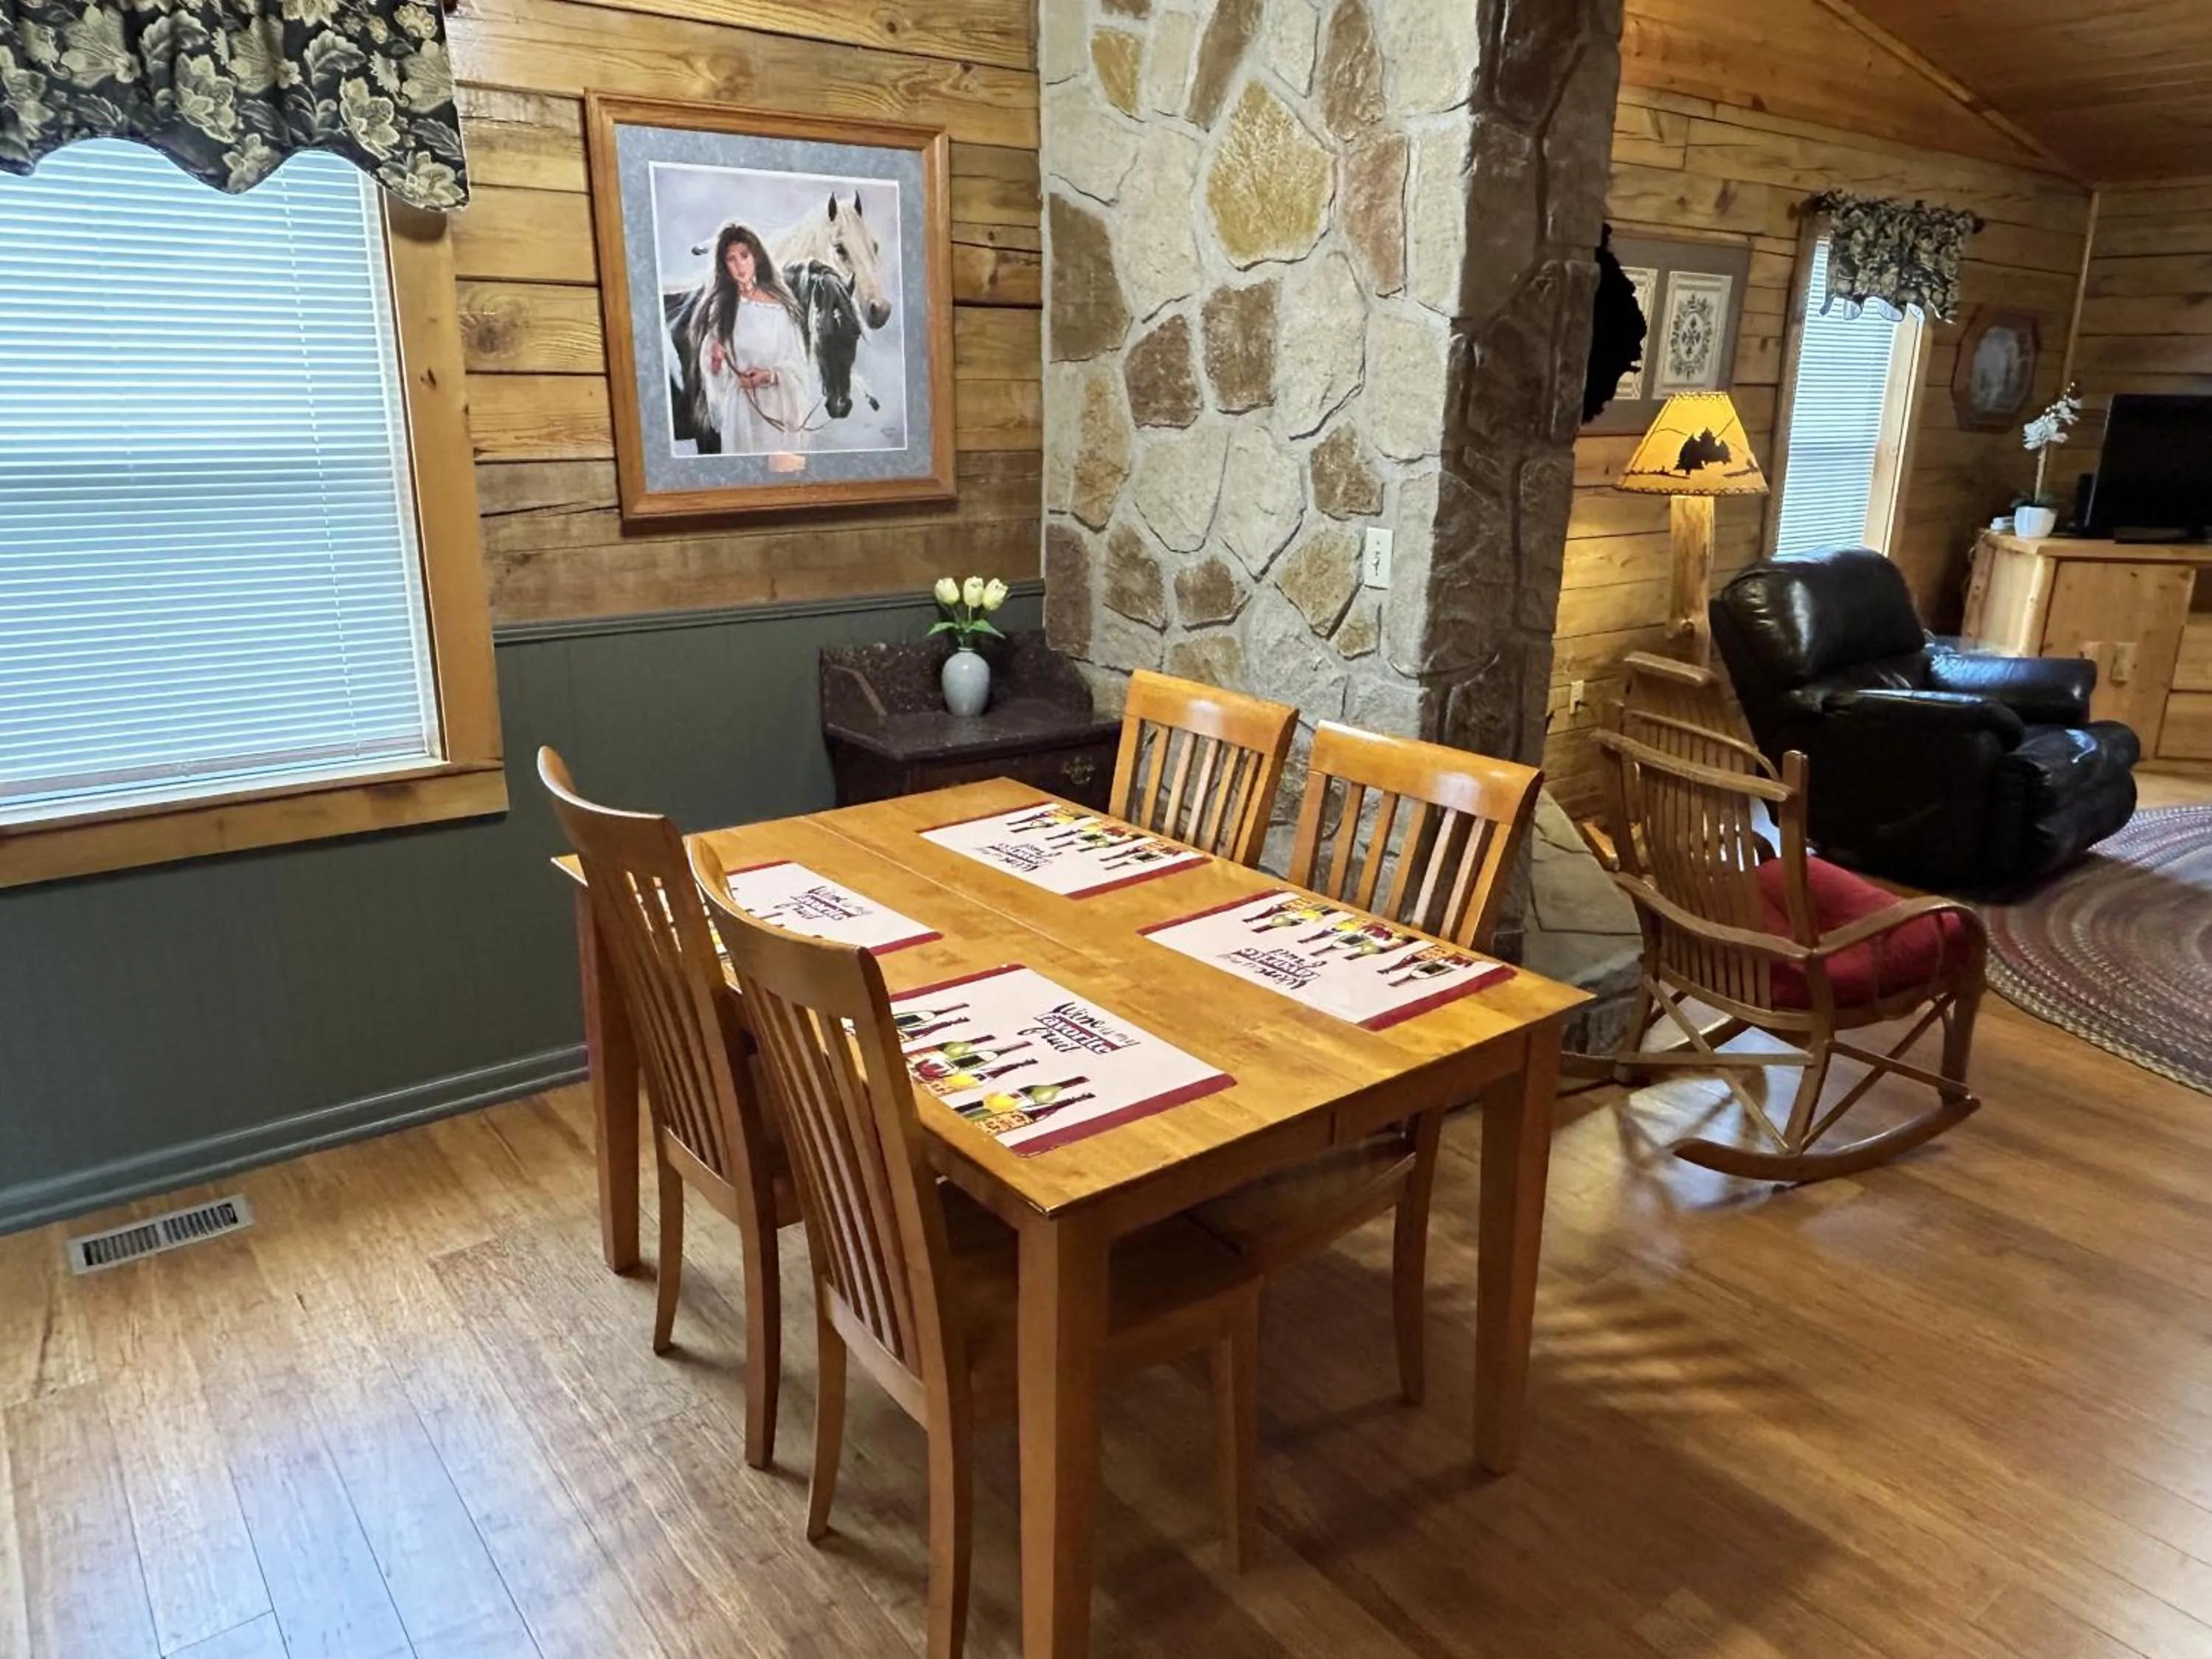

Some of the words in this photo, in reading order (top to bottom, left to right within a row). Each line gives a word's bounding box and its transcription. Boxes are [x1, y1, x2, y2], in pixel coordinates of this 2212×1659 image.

[1052, 1001, 1105, 1028] Wine
[1017, 1027, 1082, 1053] fruit
[1034, 1012, 1115, 1055] favorite
